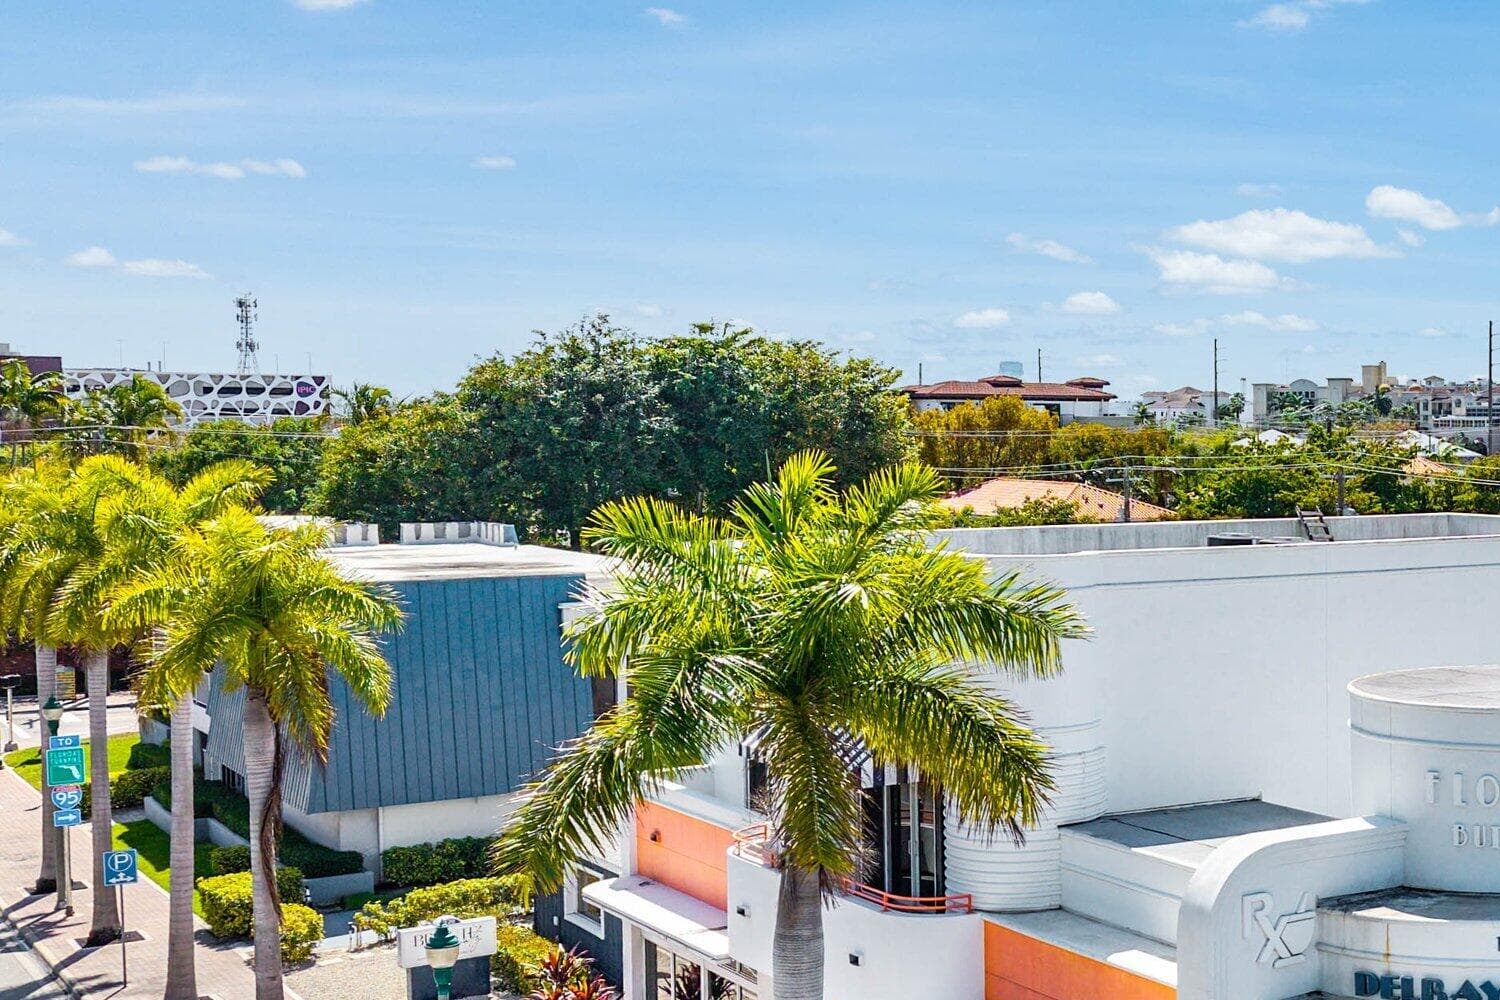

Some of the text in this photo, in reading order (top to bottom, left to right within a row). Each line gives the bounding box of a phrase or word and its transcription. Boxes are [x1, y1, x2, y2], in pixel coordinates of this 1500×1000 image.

[58, 737, 72, 746] TO
[55, 792, 79, 805] 95
[114, 854, 129, 870] P
